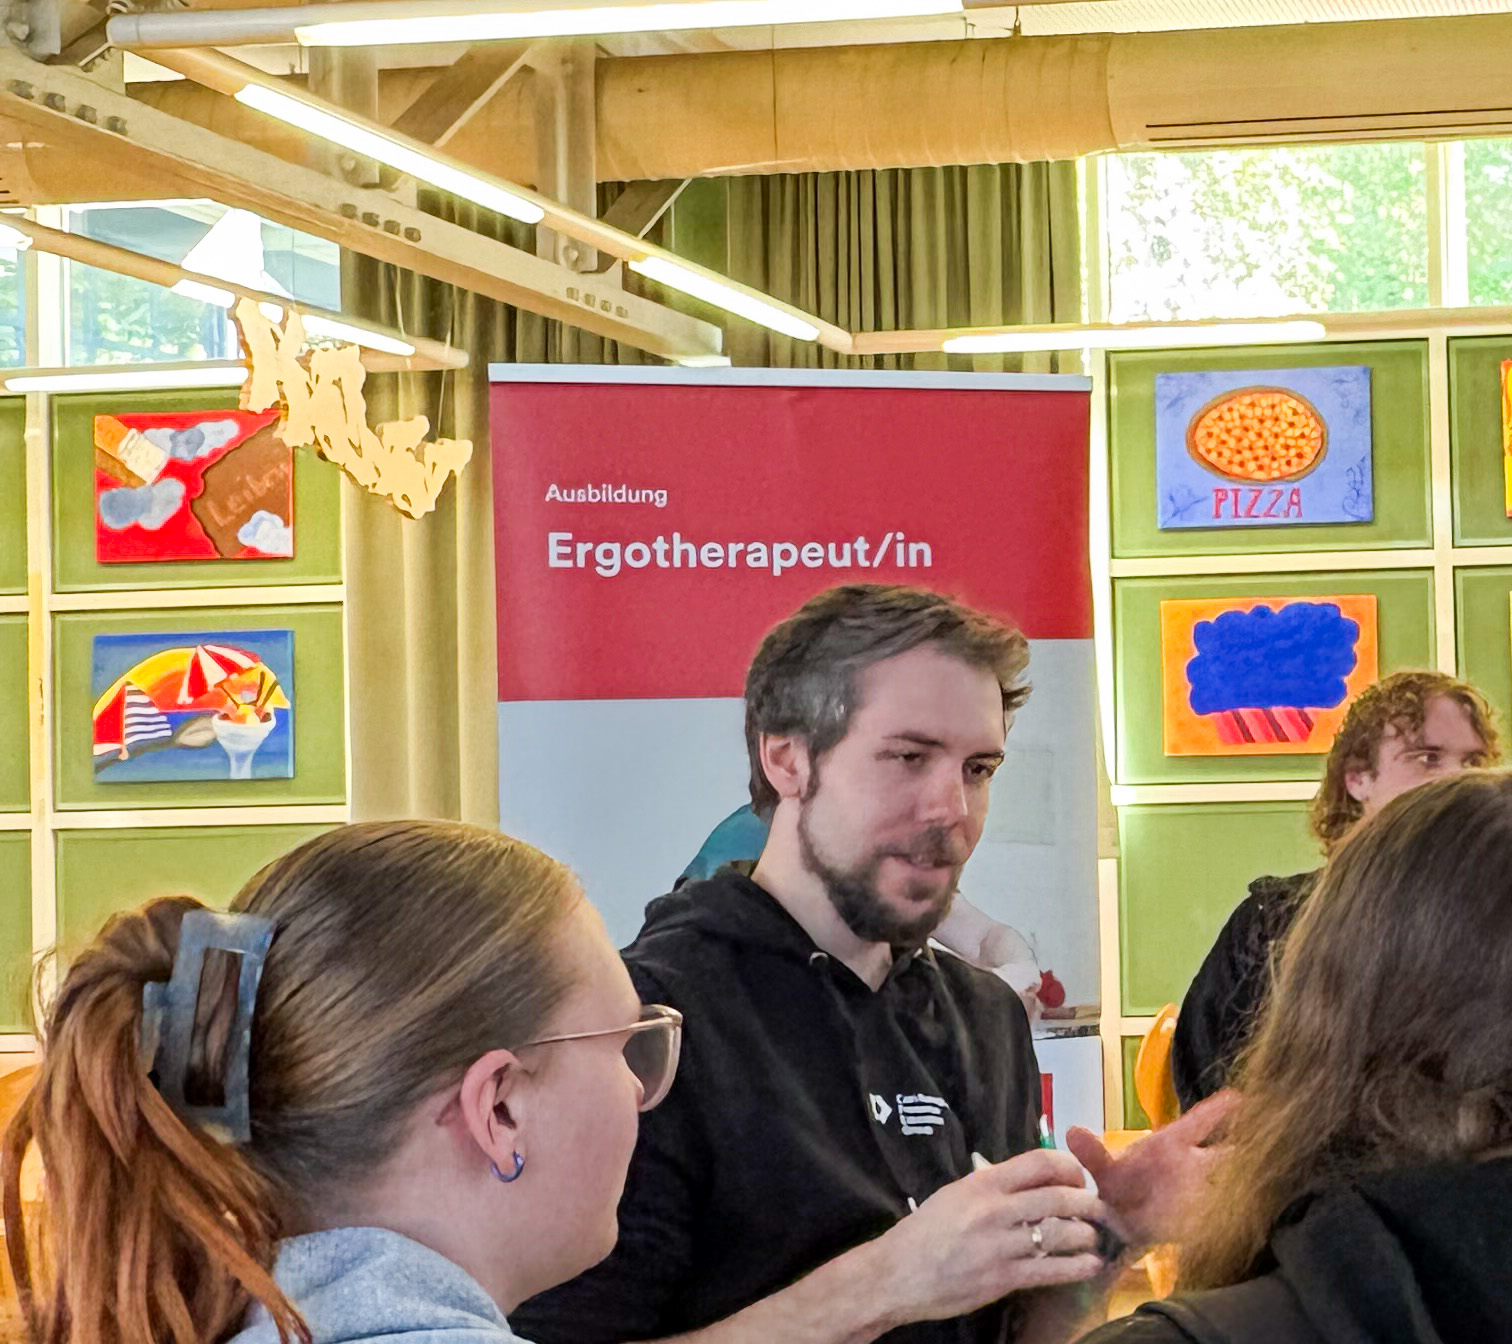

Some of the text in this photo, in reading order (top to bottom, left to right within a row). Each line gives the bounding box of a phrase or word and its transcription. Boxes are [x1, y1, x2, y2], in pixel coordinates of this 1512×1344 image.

[545, 483, 668, 508] Ausbildung
[1213, 487, 1303, 519] PIZZA
[547, 531, 932, 577] Ergotherapeut/in
